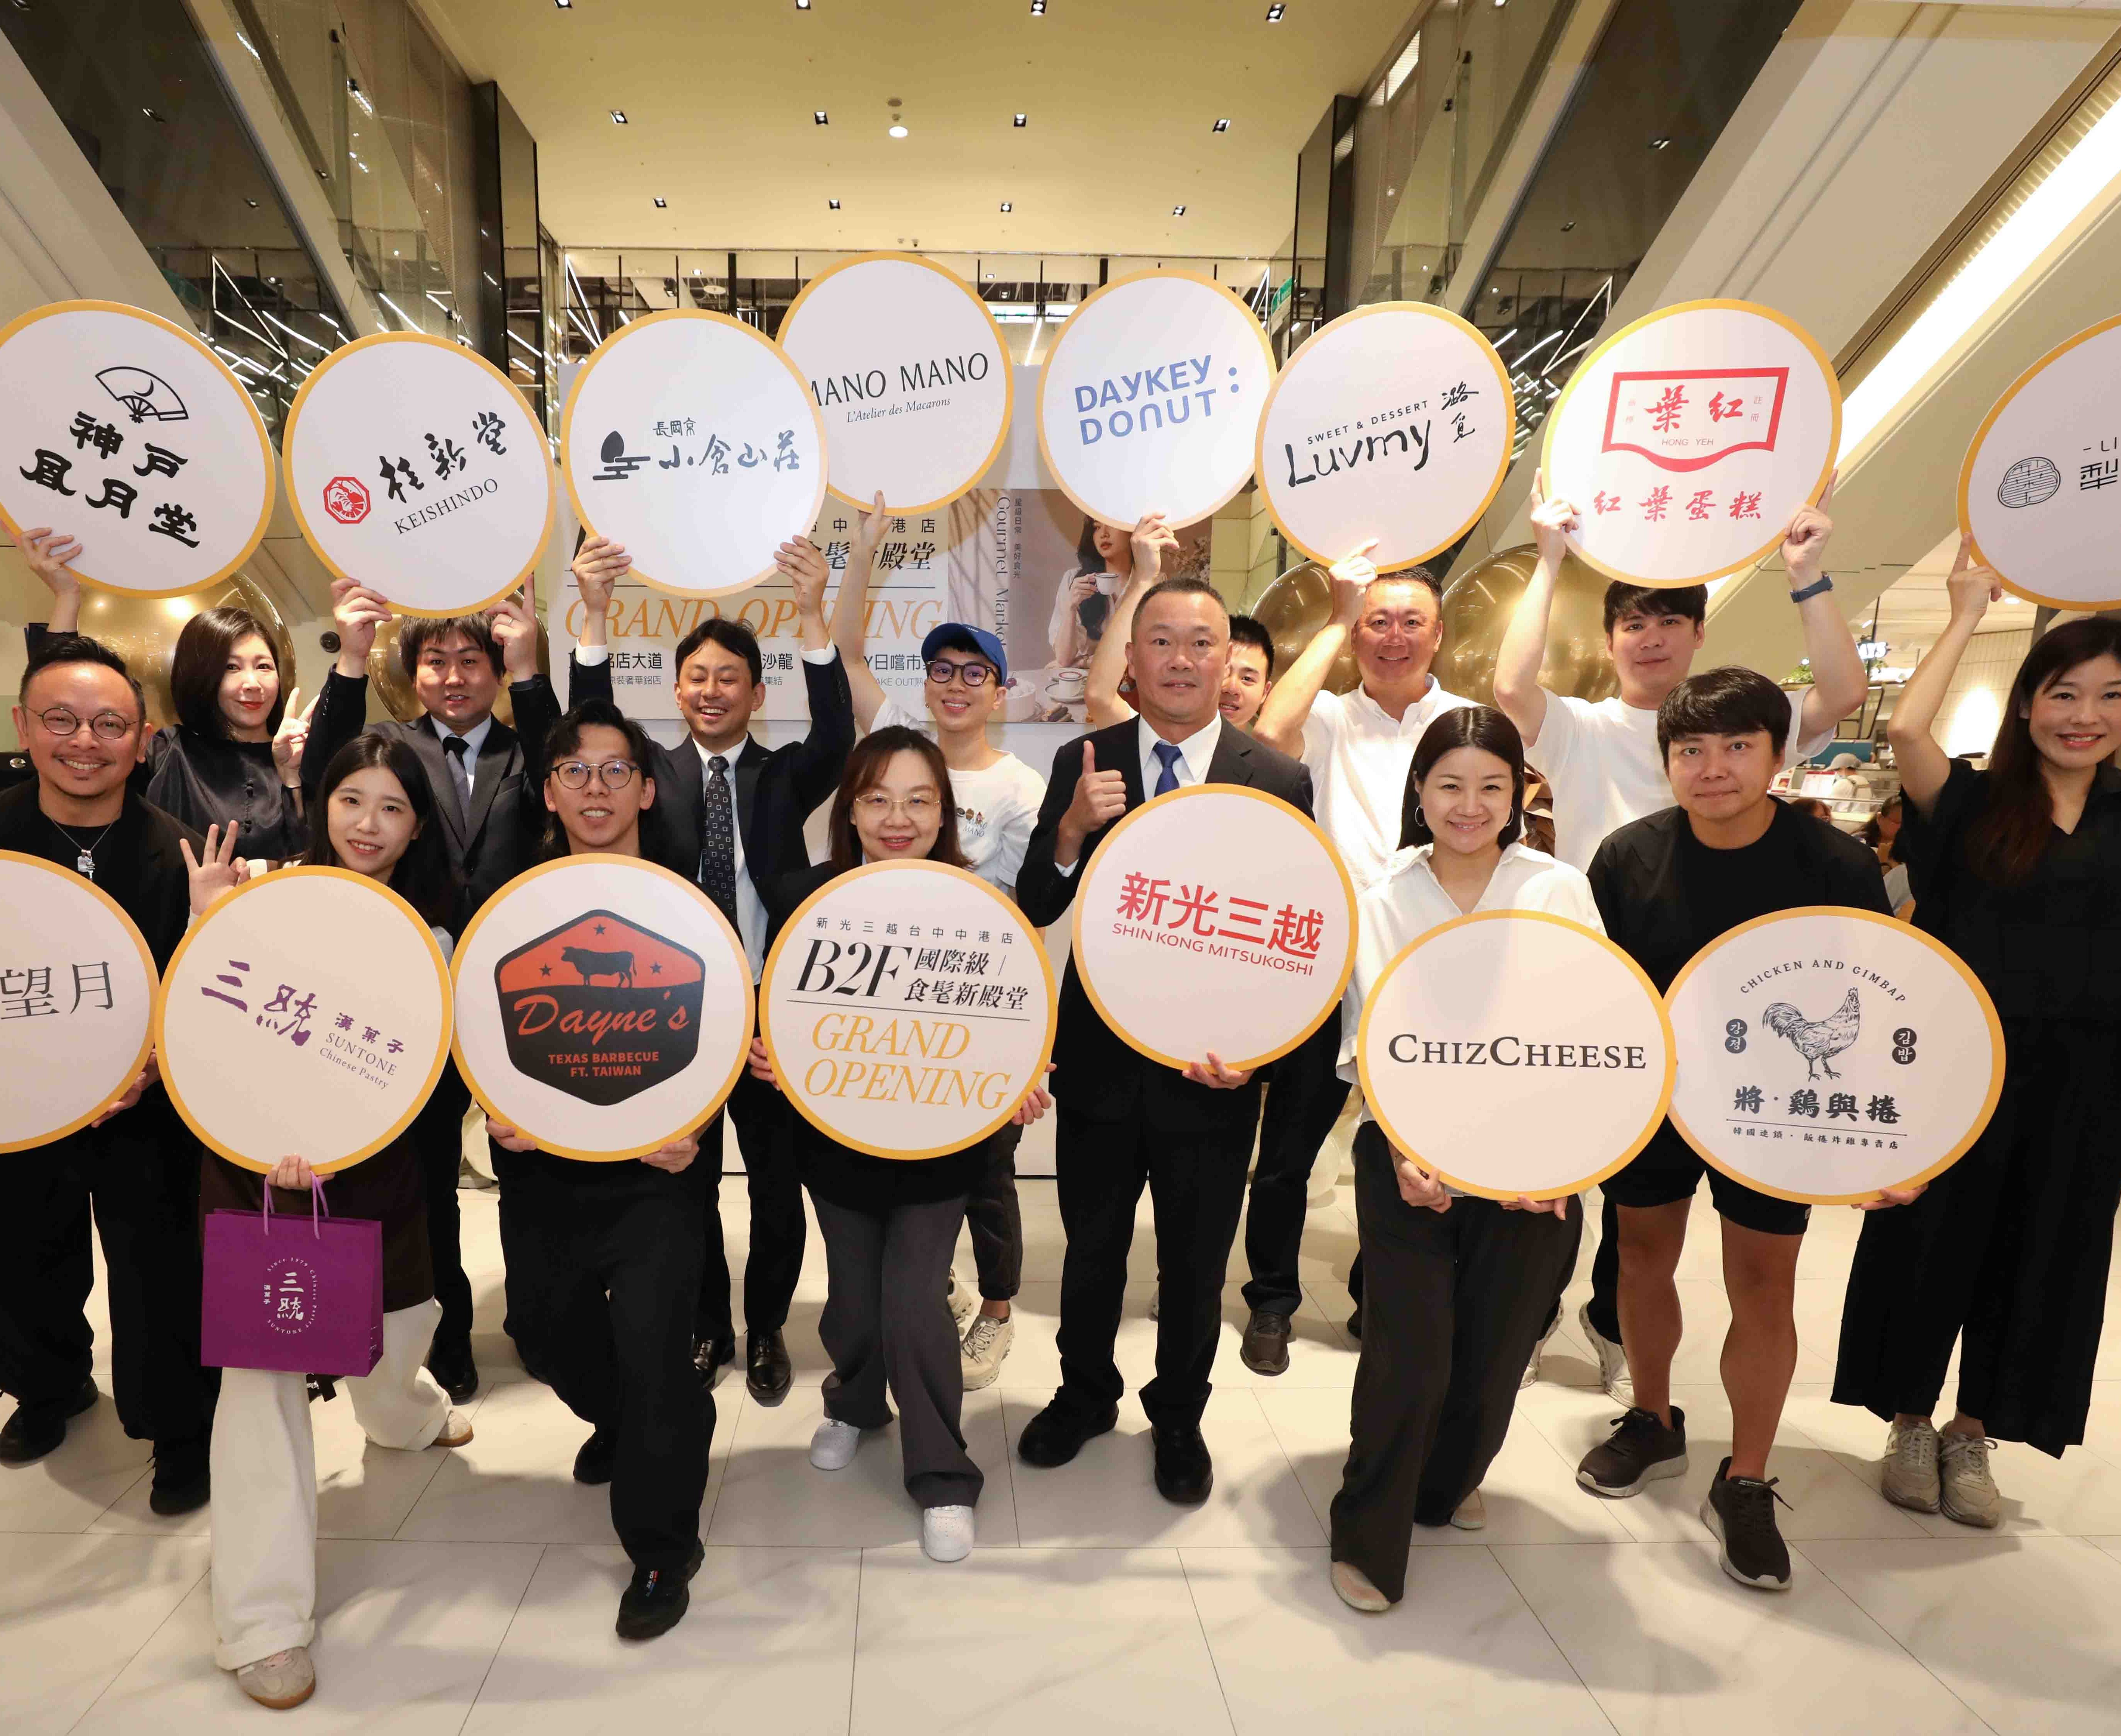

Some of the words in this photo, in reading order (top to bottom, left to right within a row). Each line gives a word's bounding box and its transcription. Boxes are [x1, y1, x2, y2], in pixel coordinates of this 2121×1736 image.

[900, 353, 988, 392] MANO
[1075, 355, 1212, 413] DAYKEY
[847, 409, 886, 423] L'Atelier
[889, 404, 902, 415] des
[906, 398, 950, 412] Macarons
[1307, 425, 1348, 444] SWEET
[1371, 400, 1428, 425] DESSERT
[1285, 420, 1431, 487] Luvmy
[393, 478, 498, 535] KEISHINDO
[1594, 486, 1763, 522] 紅葉蛋糕
[997, 497, 1010, 577] Gourmet
[762, 653, 793, 670] 沙龍
[816, 916, 1014, 944] 新光三越台中中港店
[1116, 871, 1324, 959] 新光三越
[790, 939, 912, 998] B2F
[914, 947, 990, 975] 國際級
[1112, 923, 1152, 941] SHIN
[1156, 933, 1204, 952] KONG
[1208, 944, 1313, 976] MITSUKOSHI
[0, 961, 113, 1019] 望月
[904, 978, 1028, 1011] 食髦新殿堂
[1741, 961, 1803, 994] CHICKEN
[1812, 959, 1844, 970] AND
[1852, 966, 1906, 1003] GIMBAP
[514, 990, 690, 1045] Dayne's
[812, 1013, 970, 1059] GRAND
[1729, 1022, 1744, 1050] 강정
[325, 1032, 398, 1076] SUNTONE
[548, 1054, 589, 1064] TEXAS
[592, 1051, 659, 1063] BARBECUE
[1898, 1031, 1912, 1061] 김밥
[320, 1047, 356, 1073] Chinese
[359, 1068, 389, 1090] Pastry
[570, 1067, 588, 1077] FT.
[592, 1066, 641, 1076] TAIWAN
[804, 1059, 1012, 1110] OPENING
